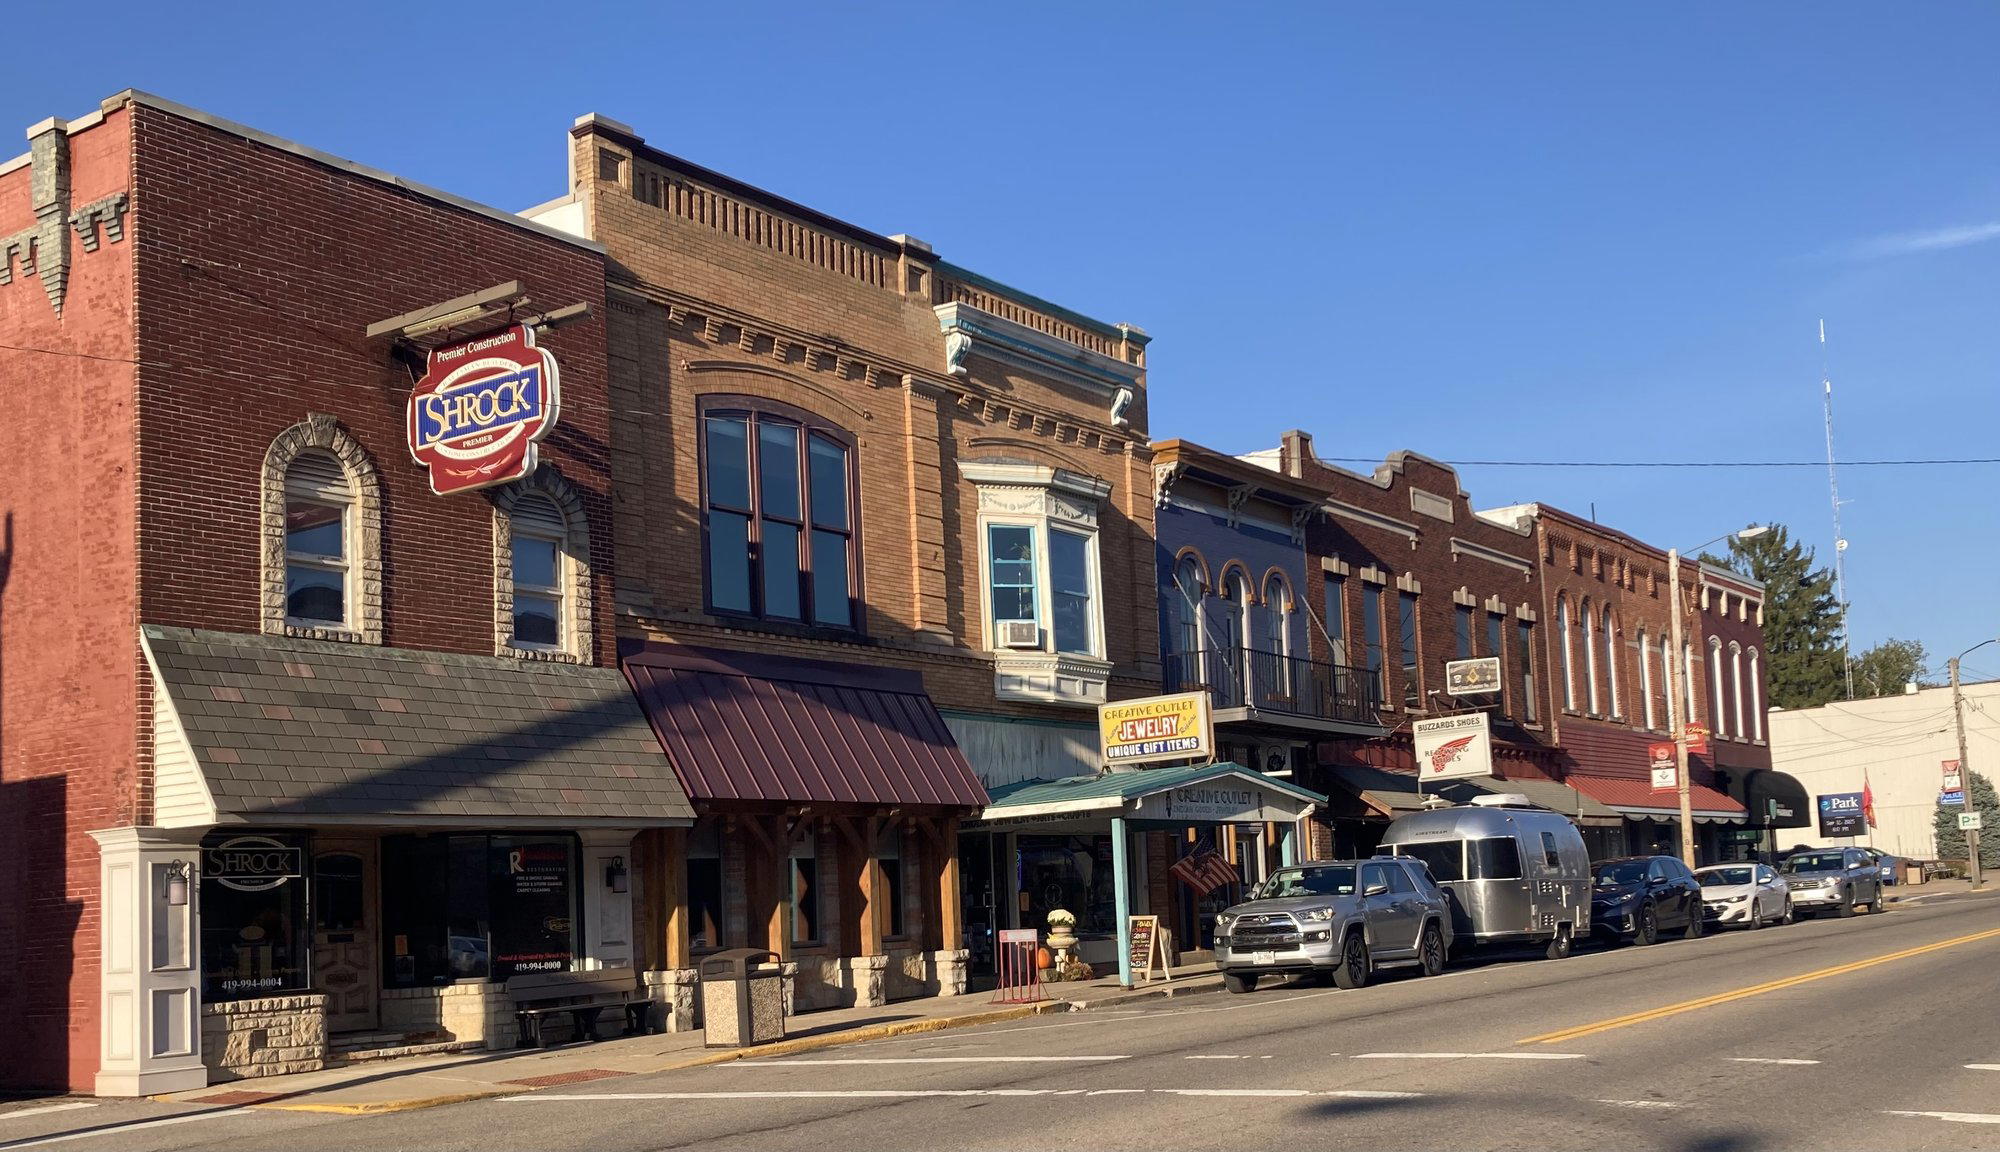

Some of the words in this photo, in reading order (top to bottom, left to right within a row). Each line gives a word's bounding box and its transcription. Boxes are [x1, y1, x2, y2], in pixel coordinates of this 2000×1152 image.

[436, 347, 466, 363] Premier
[467, 332, 516, 354] Construction
[426, 378, 530, 442] SHROCK
[462, 434, 494, 448] PREMIER
[1104, 706, 1152, 720] CREATIVE
[1156, 700, 1194, 714] OUTLET
[1120, 716, 1178, 740] JEWELRY
[1418, 721, 1454, 732] BUZZARDS
[1456, 717, 1480, 728] SHOES
[1108, 744, 1142, 758] UNIQUE
[1143, 741, 1164, 754] GIFT
[1166, 738, 1197, 751] ITEMS
[1177, 788, 1220, 804] CREATIVE
[1221, 790, 1252, 805] OUTLET
[1832, 796, 1859, 809] Park
[1962, 816, 1970, 826] P
[208, 848, 292, 876] SHROCK
[510, 851, 524, 874] R
[514, 961, 562, 972] 419-994-0000
[222, 976, 282, 990] 419-994-0004
